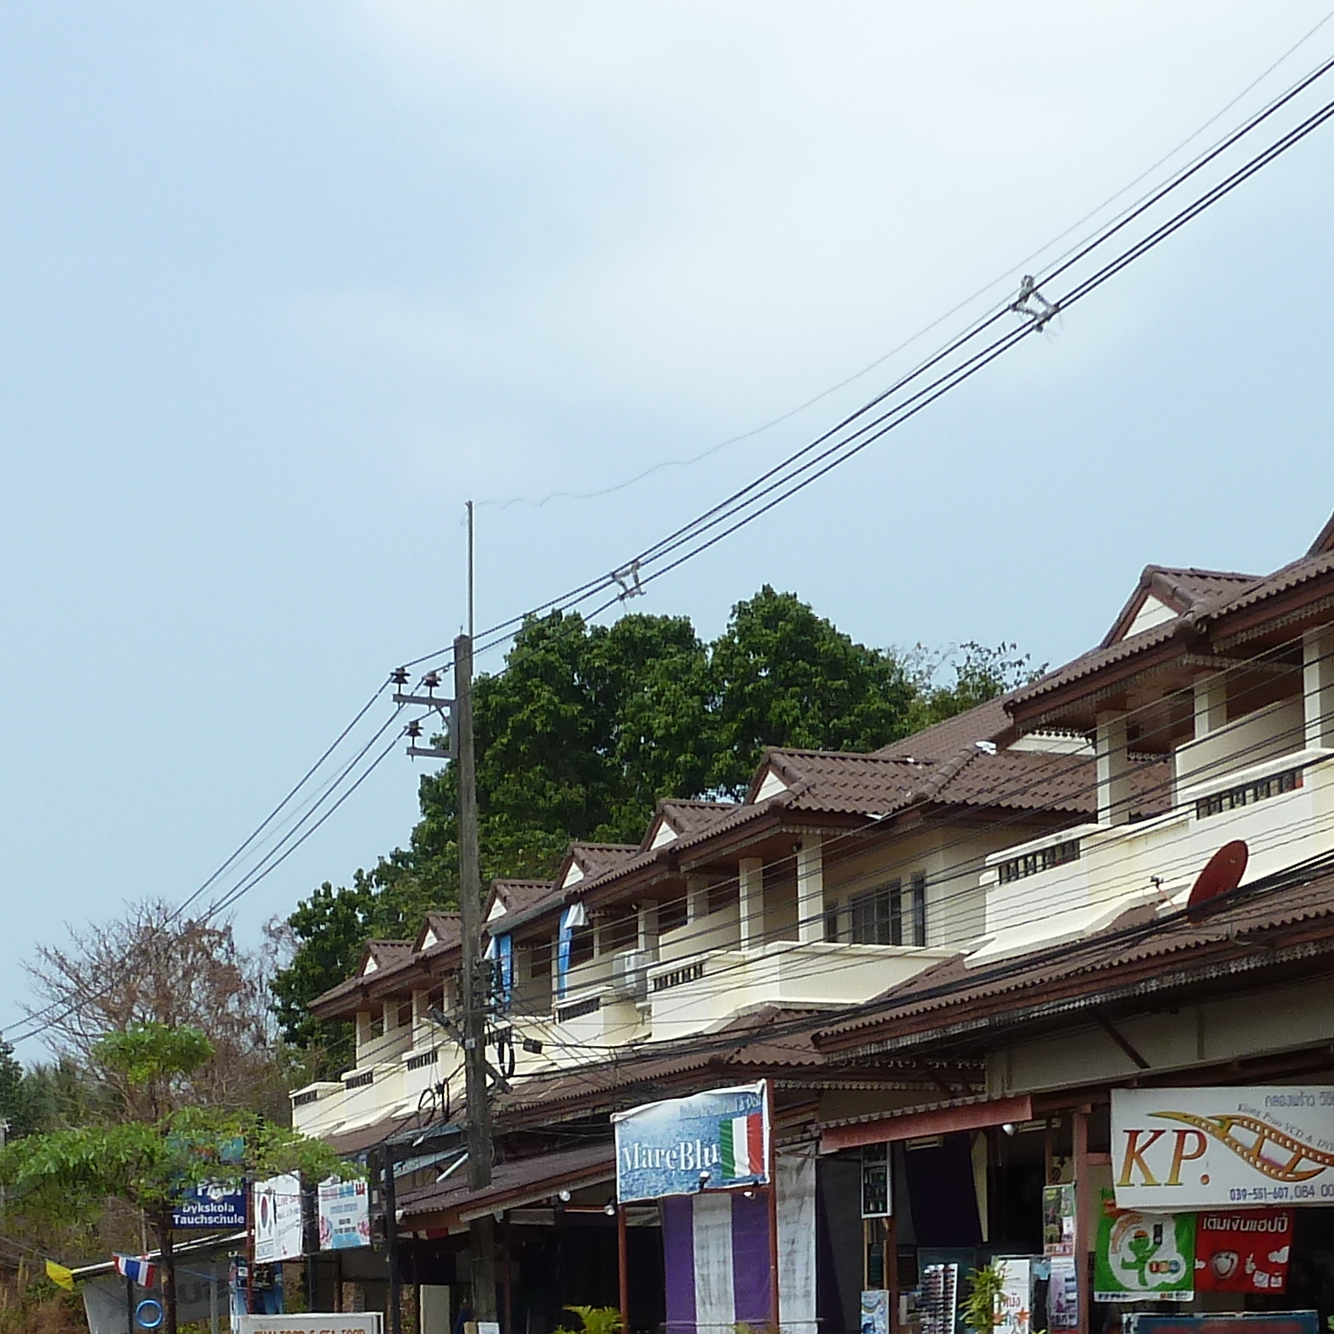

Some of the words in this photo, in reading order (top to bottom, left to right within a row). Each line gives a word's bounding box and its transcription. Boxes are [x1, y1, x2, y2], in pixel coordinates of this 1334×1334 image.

[1285, 1123, 1304, 1138] VCD
[182, 1202, 235, 1214] Dykskola
[172, 1213, 245, 1225] Tauchschule
